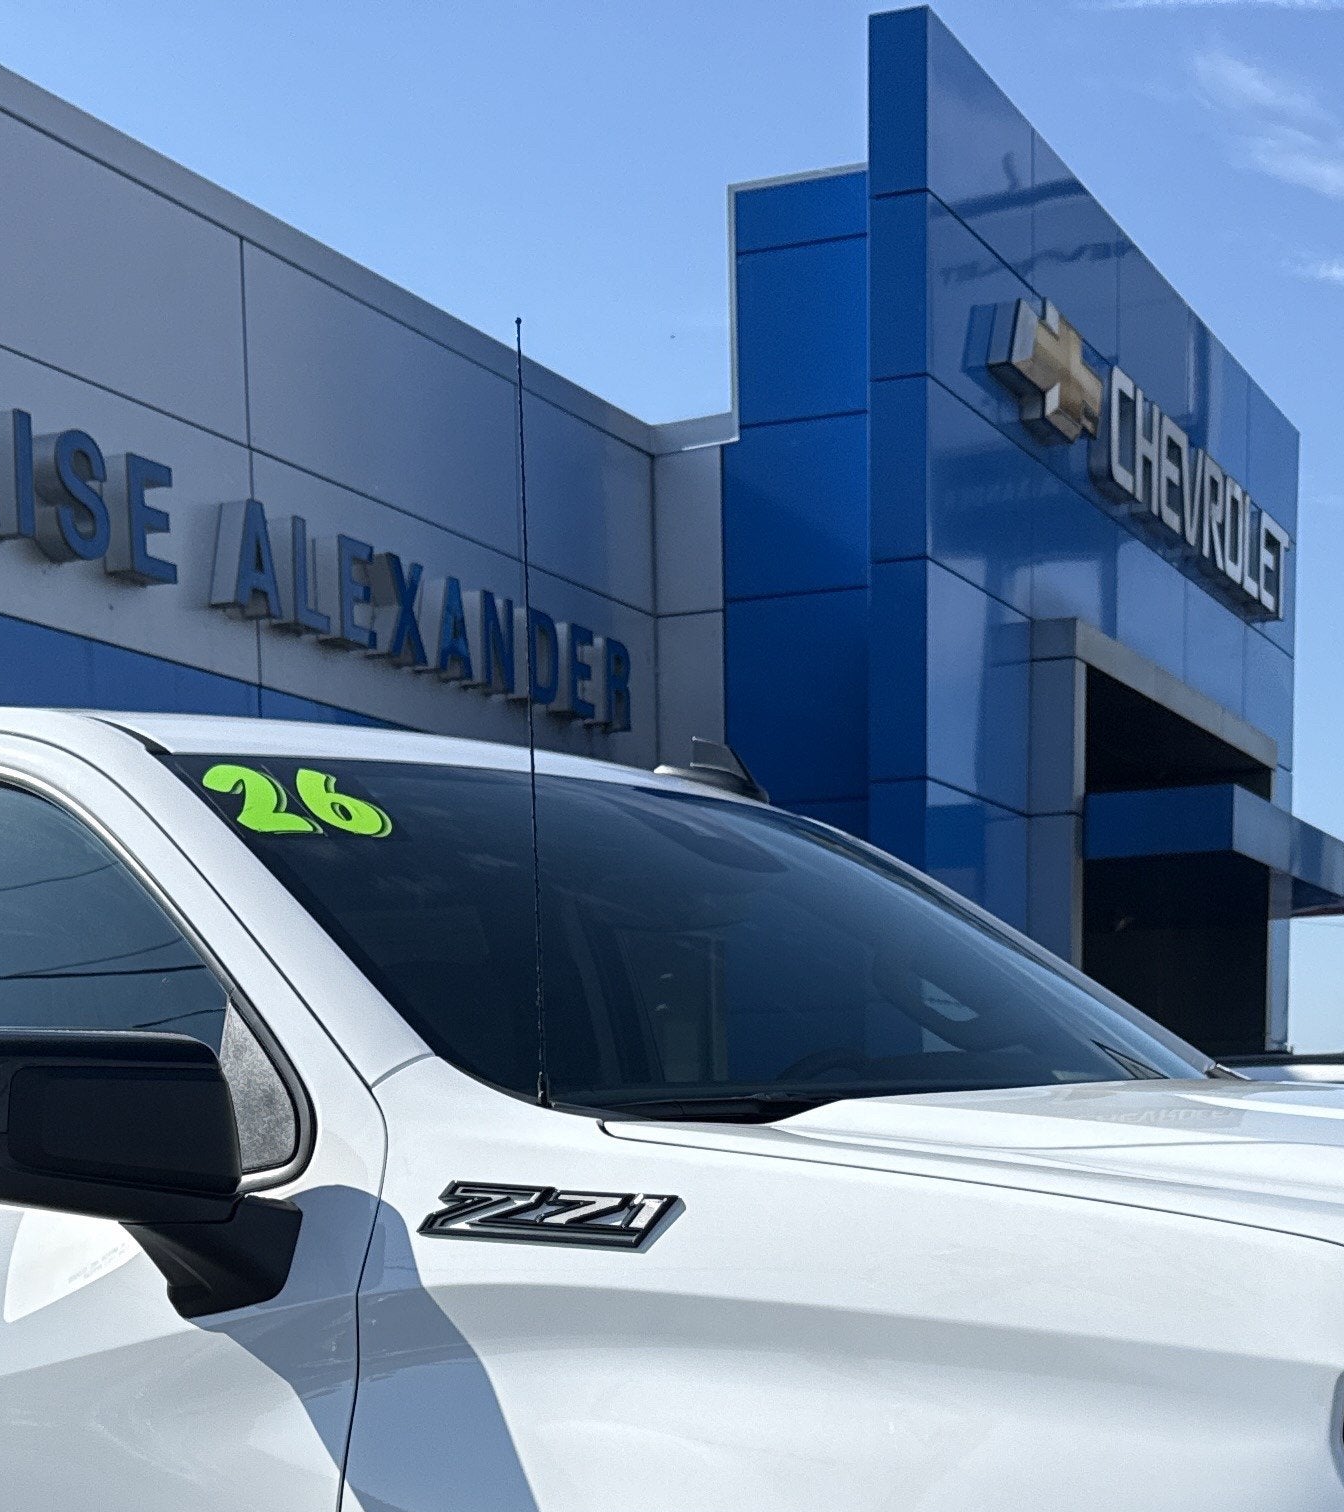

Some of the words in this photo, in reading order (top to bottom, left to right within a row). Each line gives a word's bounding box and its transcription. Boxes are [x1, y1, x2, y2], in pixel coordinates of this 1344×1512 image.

[1109, 364, 1291, 621] CHEVROLET
[234, 498, 633, 733] ALEXANDER
[202, 763, 393, 838] 26
[416, 1180, 681, 1251] Z71
